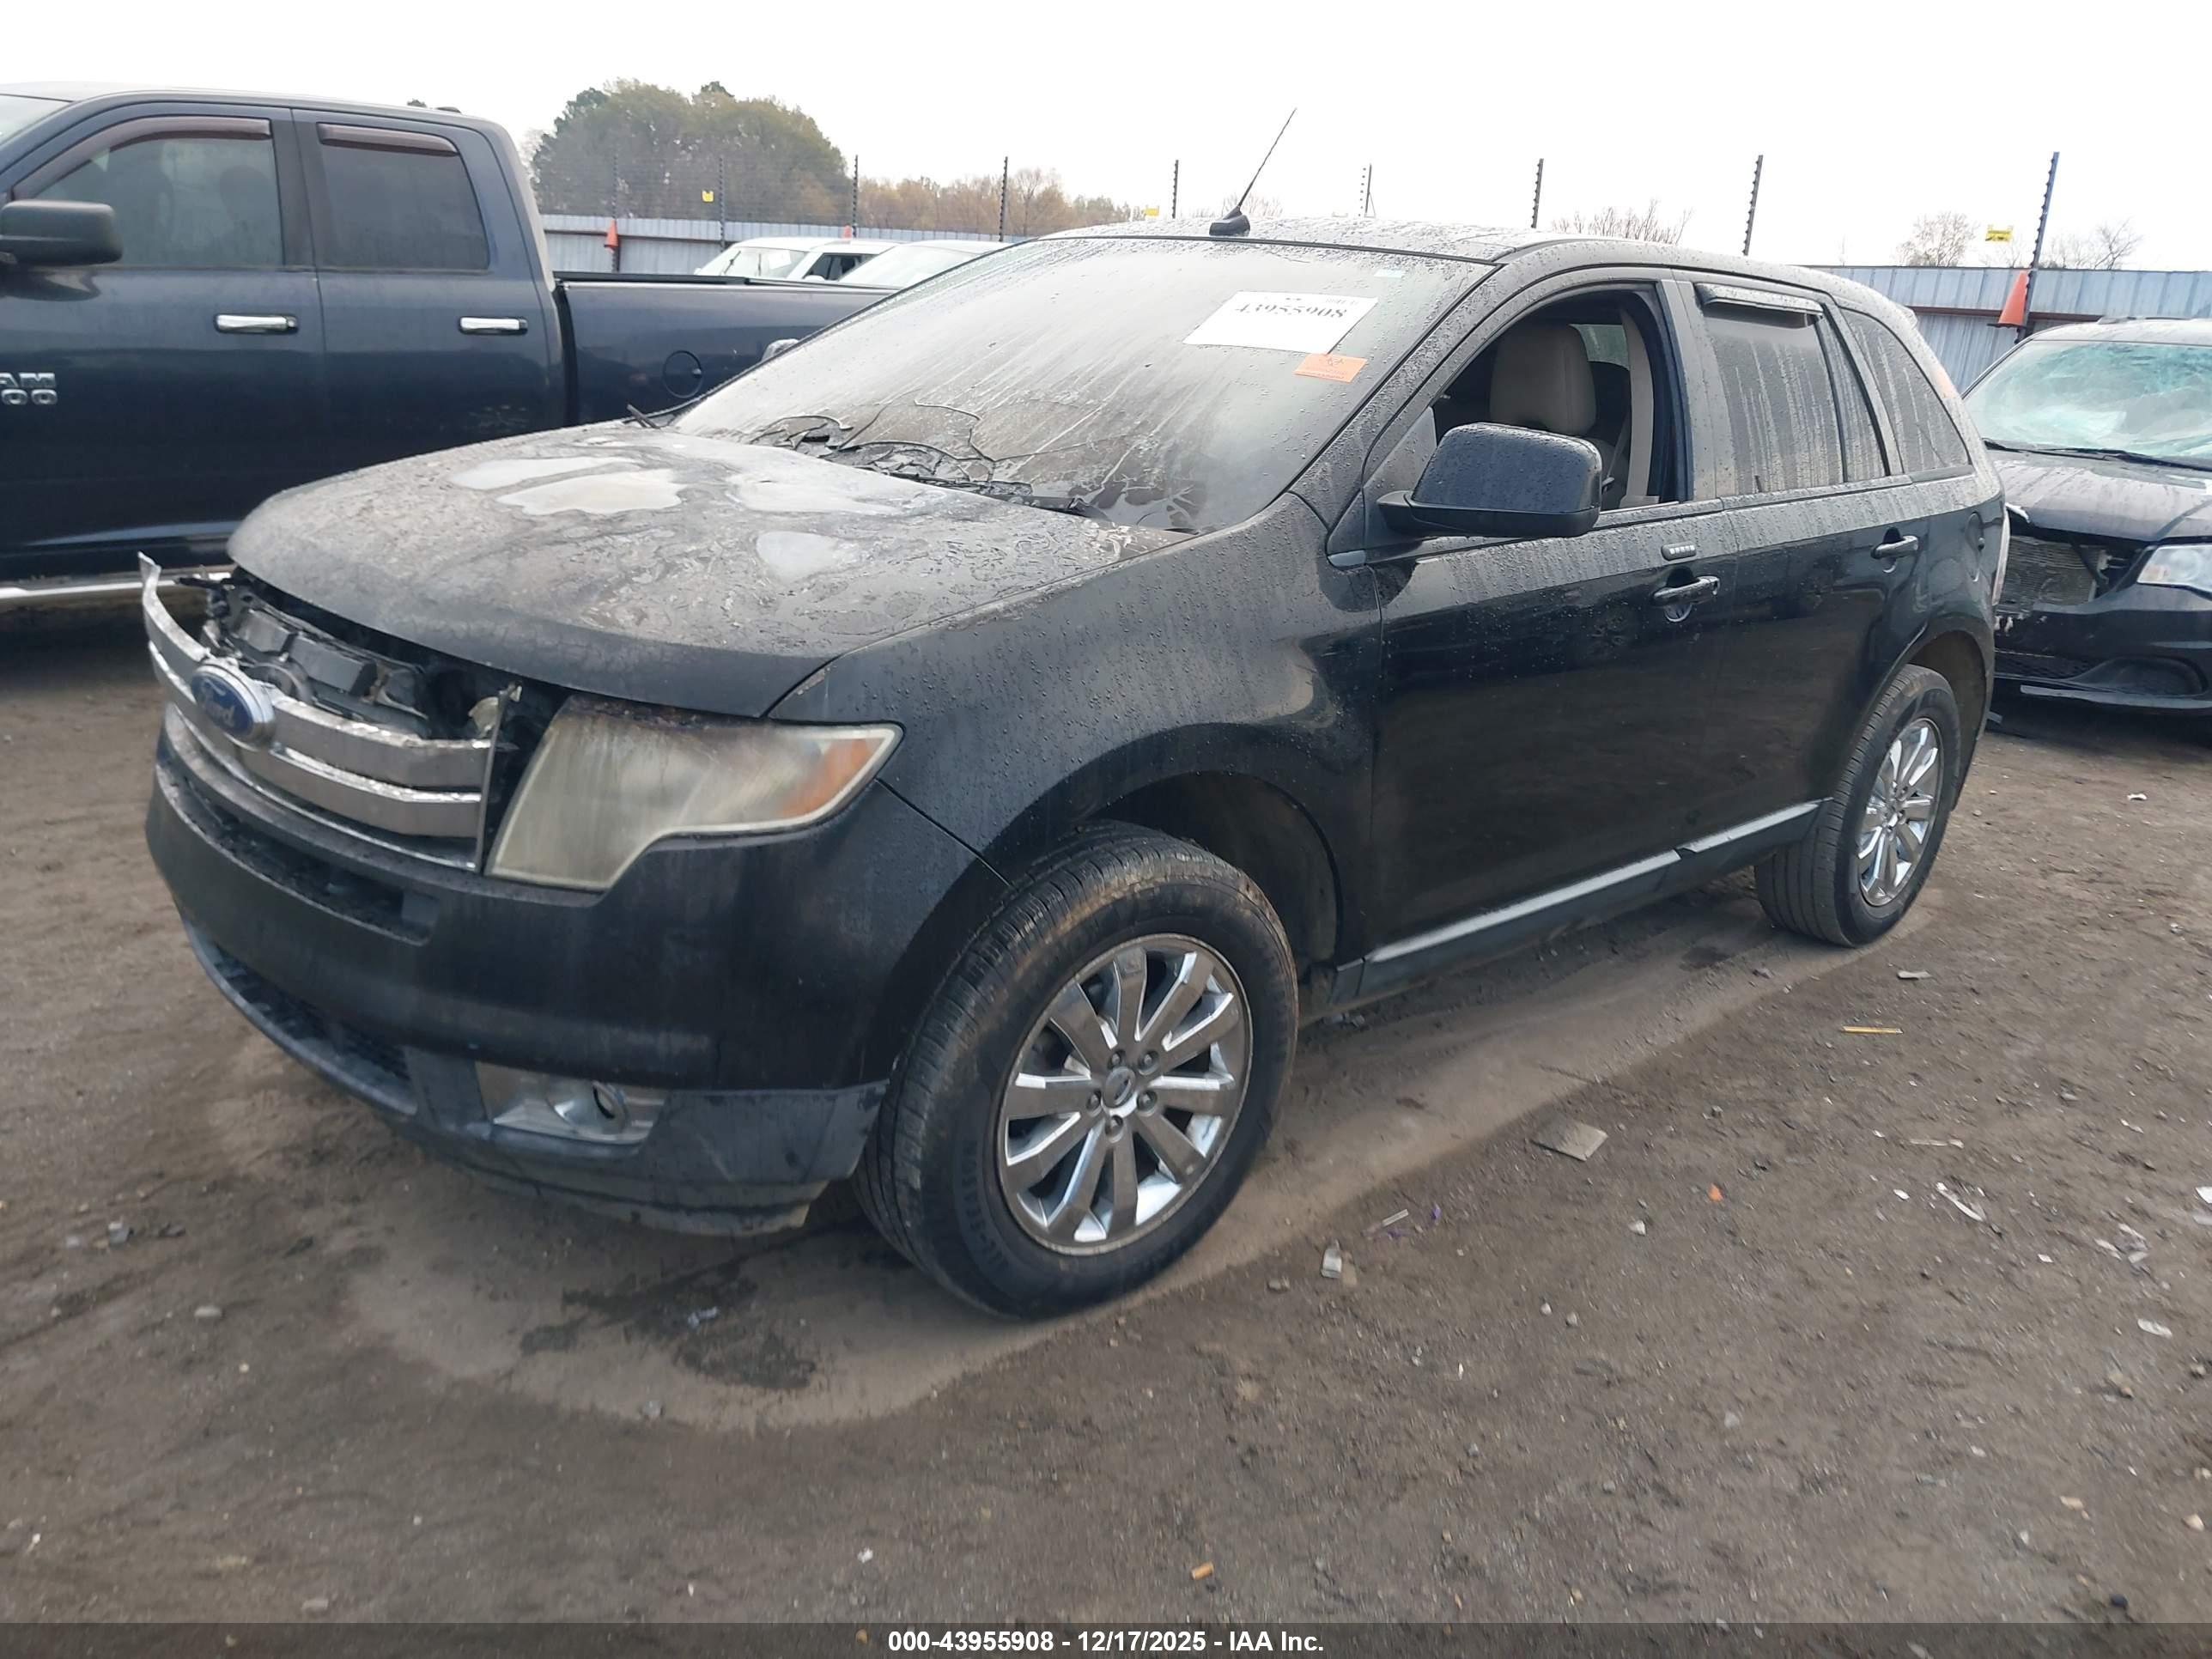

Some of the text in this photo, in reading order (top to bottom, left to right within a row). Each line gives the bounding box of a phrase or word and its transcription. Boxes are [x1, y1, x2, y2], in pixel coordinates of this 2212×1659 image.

[0, 372, 56, 388] AM
[0, 388, 58, 405] 00
[198, 677, 236, 728] Ford
